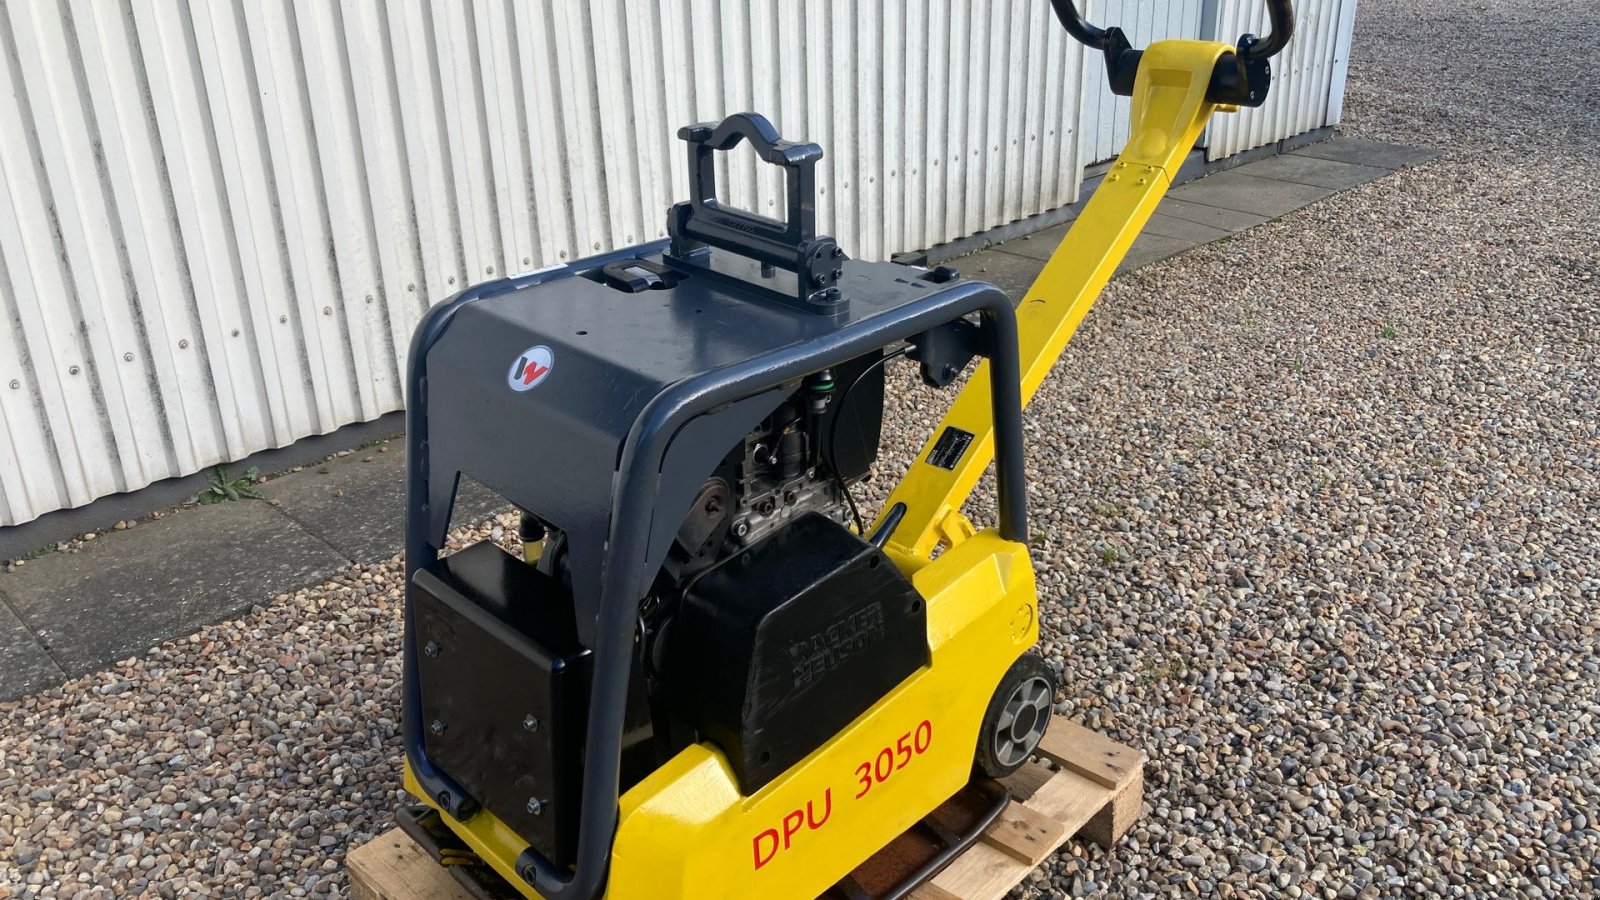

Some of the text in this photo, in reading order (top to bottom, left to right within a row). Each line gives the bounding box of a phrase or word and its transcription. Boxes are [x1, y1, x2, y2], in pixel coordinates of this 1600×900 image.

[787, 601, 884, 668] WACKER
[792, 629, 884, 688] NEUSON
[752, 719, 932, 871] DPU 3050
